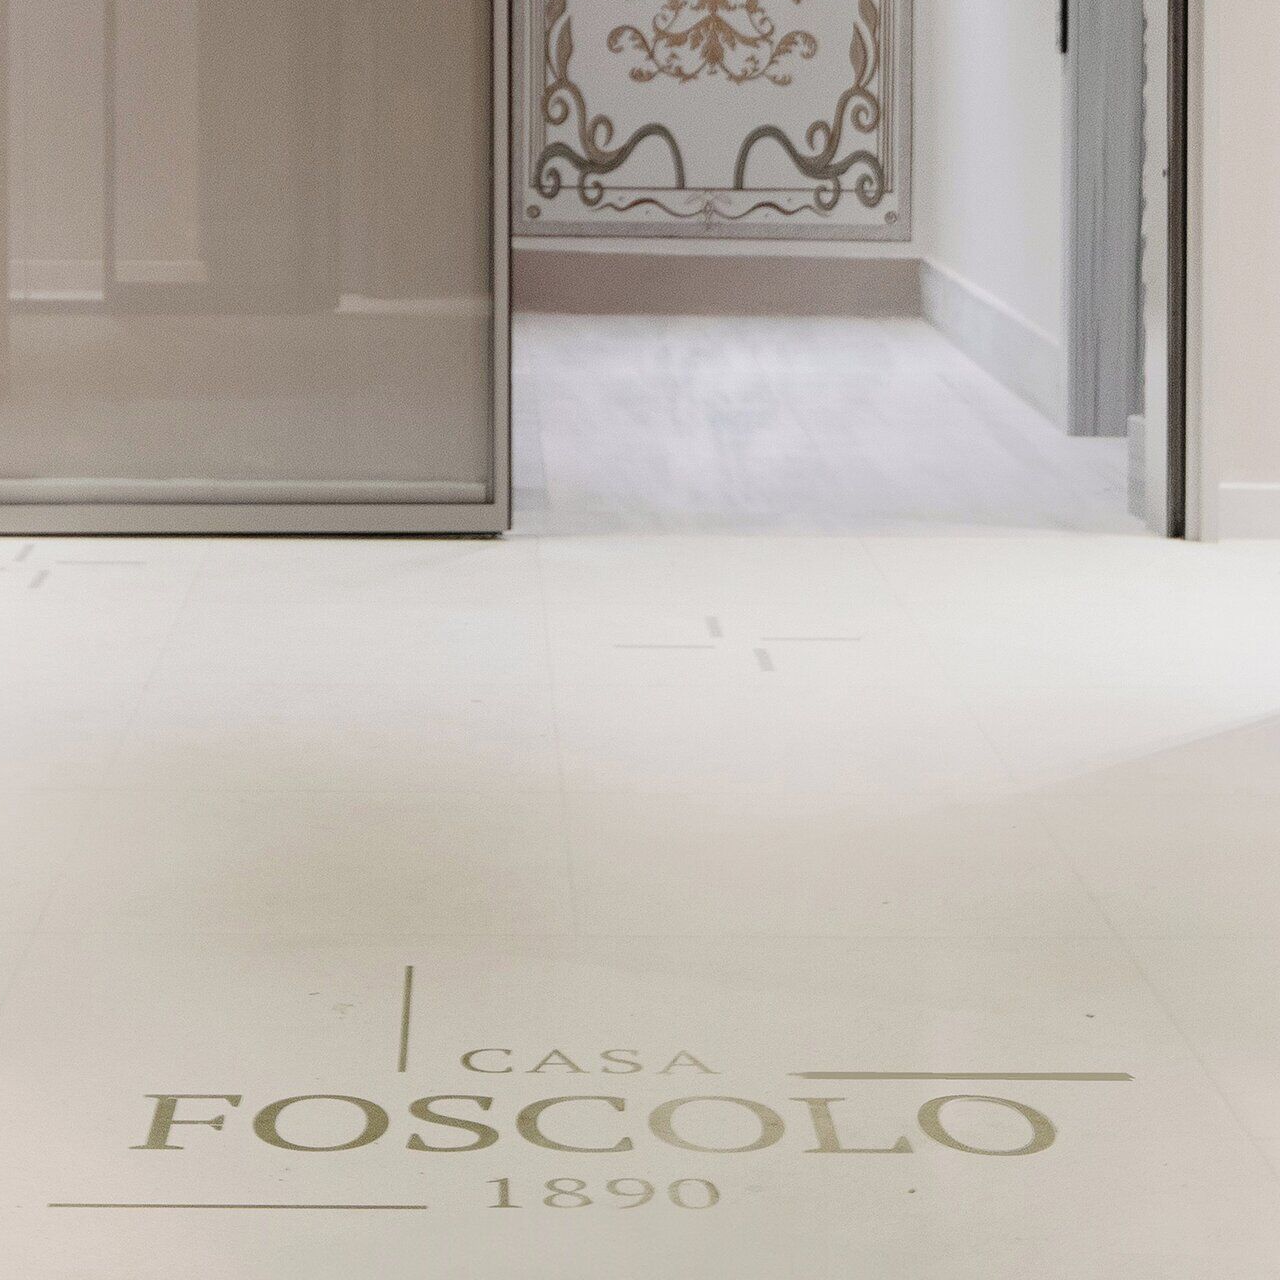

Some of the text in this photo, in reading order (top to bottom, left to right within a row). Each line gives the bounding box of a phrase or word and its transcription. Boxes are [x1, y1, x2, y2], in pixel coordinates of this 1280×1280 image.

[460, 1047, 720, 1075] CASA
[127, 1093, 1058, 1157] FOSCOLO
[485, 1176, 720, 1210] 1890
